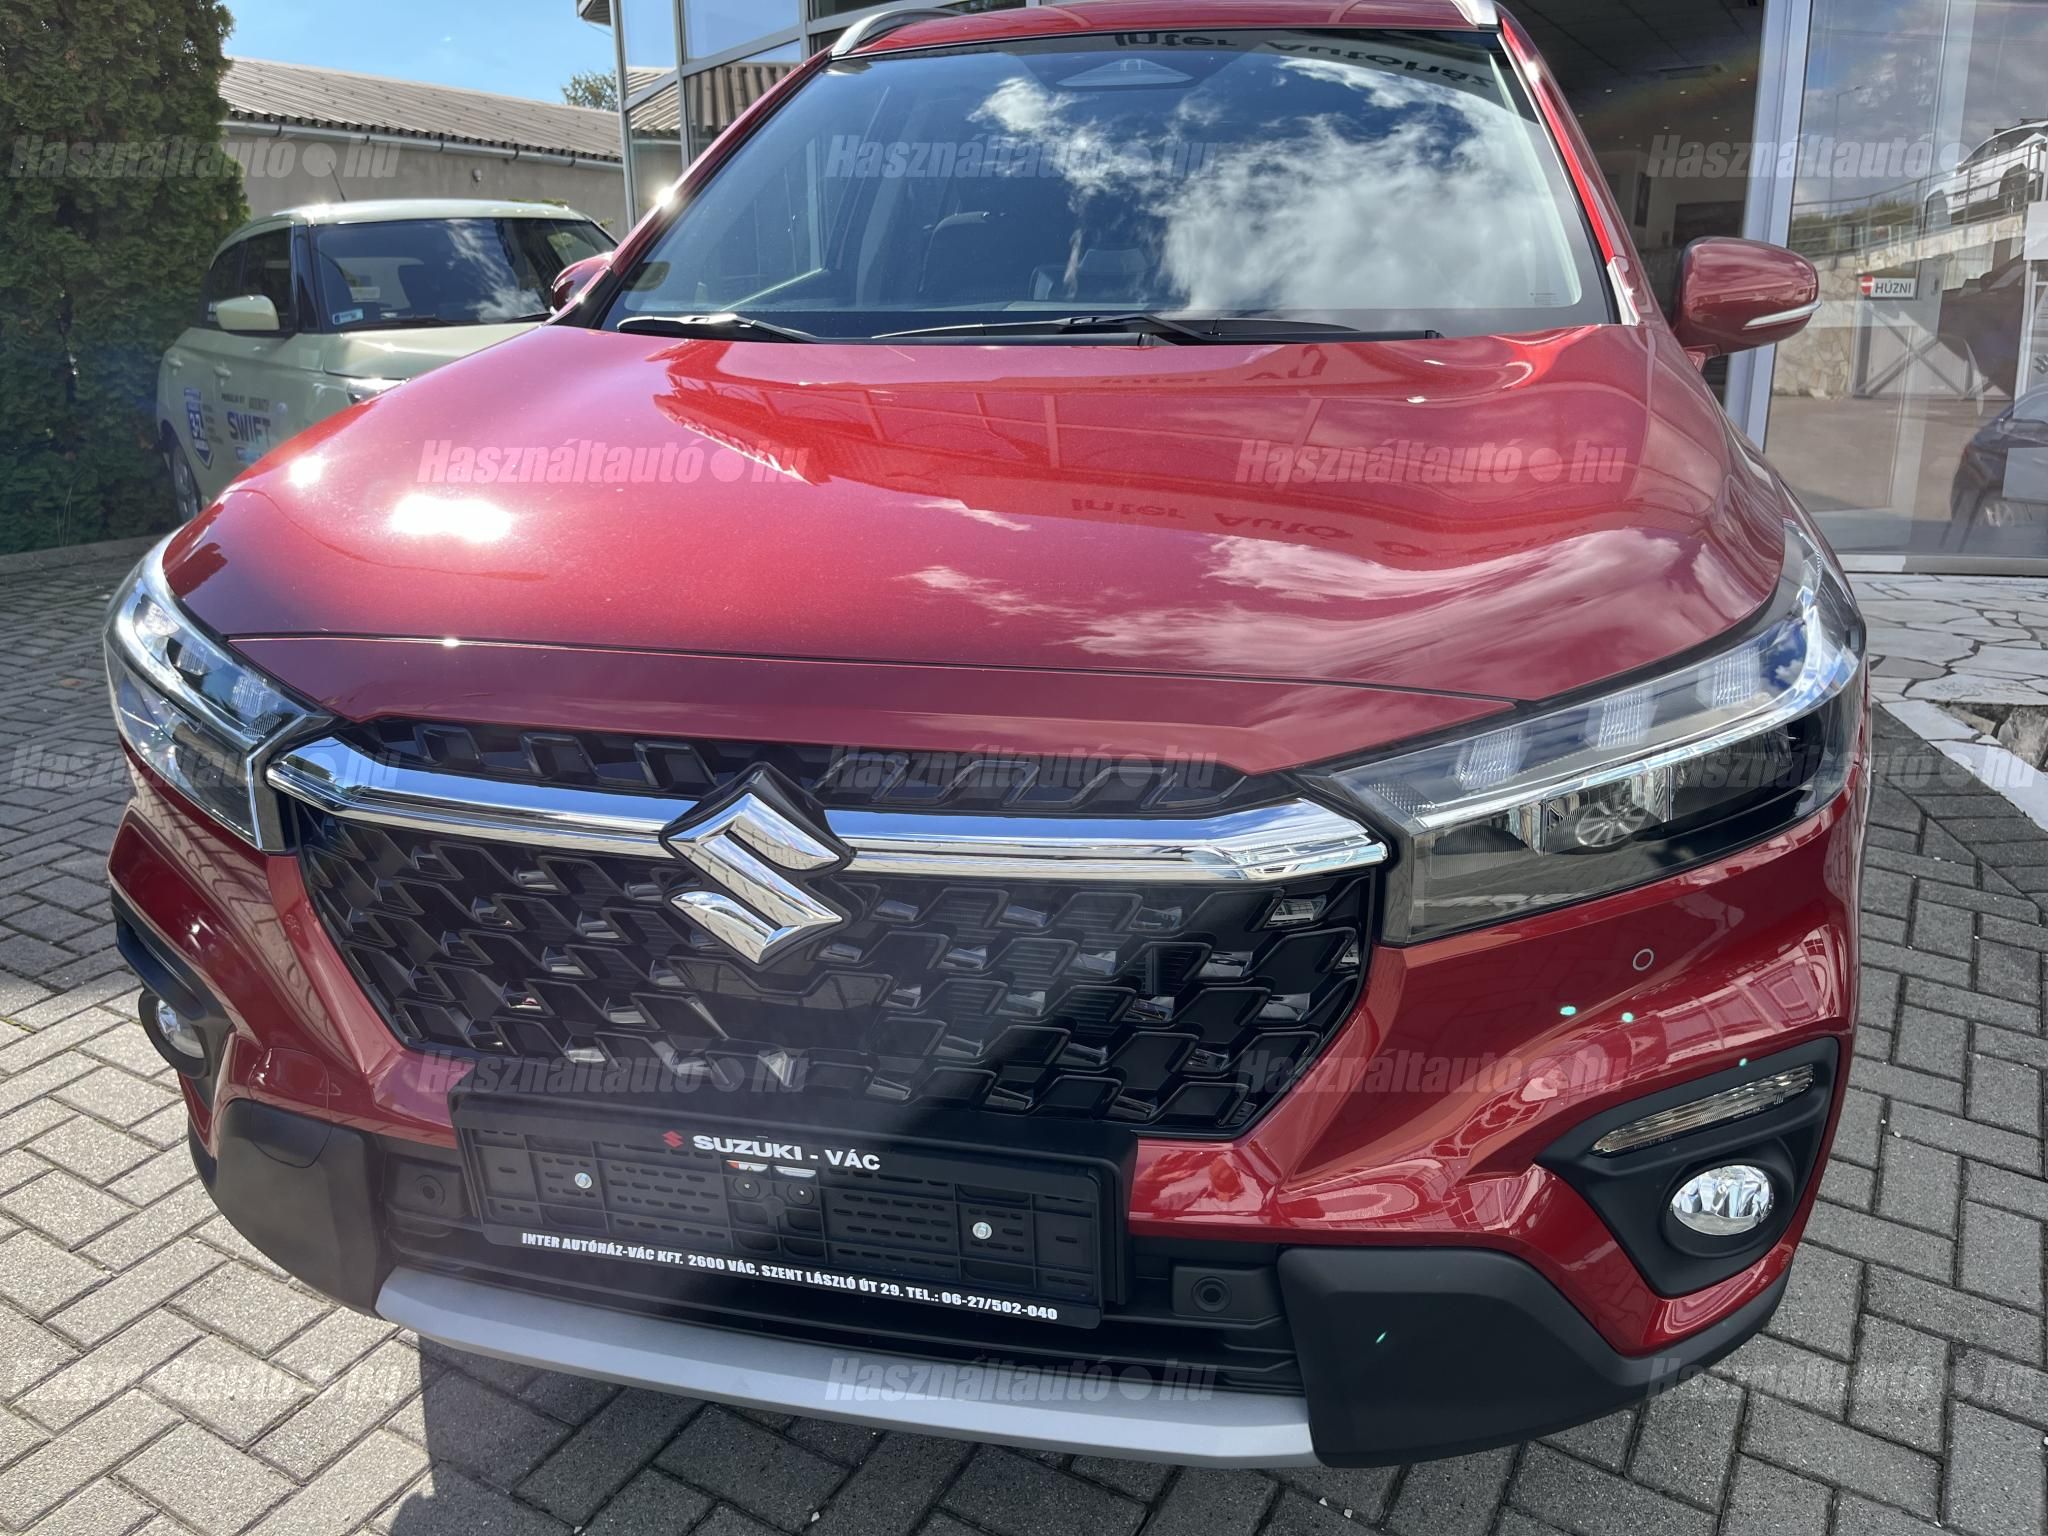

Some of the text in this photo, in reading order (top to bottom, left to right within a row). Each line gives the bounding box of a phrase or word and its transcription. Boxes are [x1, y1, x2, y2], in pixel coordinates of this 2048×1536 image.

[227, 410, 271, 447] SWIFT
[692, 1134, 803, 1161] SUZUKI
[824, 1148, 881, 1171] VÁC
[521, 1232, 560, 1249] INTER
[561, 1237, 655, 1261] AUTÓHÁZ-VÁC
[657, 1250, 684, 1265] KFT.
[687, 1254, 726, 1270] 2600
[761, 1264, 804, 1283] SZENT
[805, 1271, 856, 1291] LÁSZLÓ
[858, 1277, 878, 1293] ÚT
[880, 1282, 904, 1298] 29.
[905, 1286, 939, 1303] TEL.:
[941, 1291, 1058, 1321] 06-27/502-040
